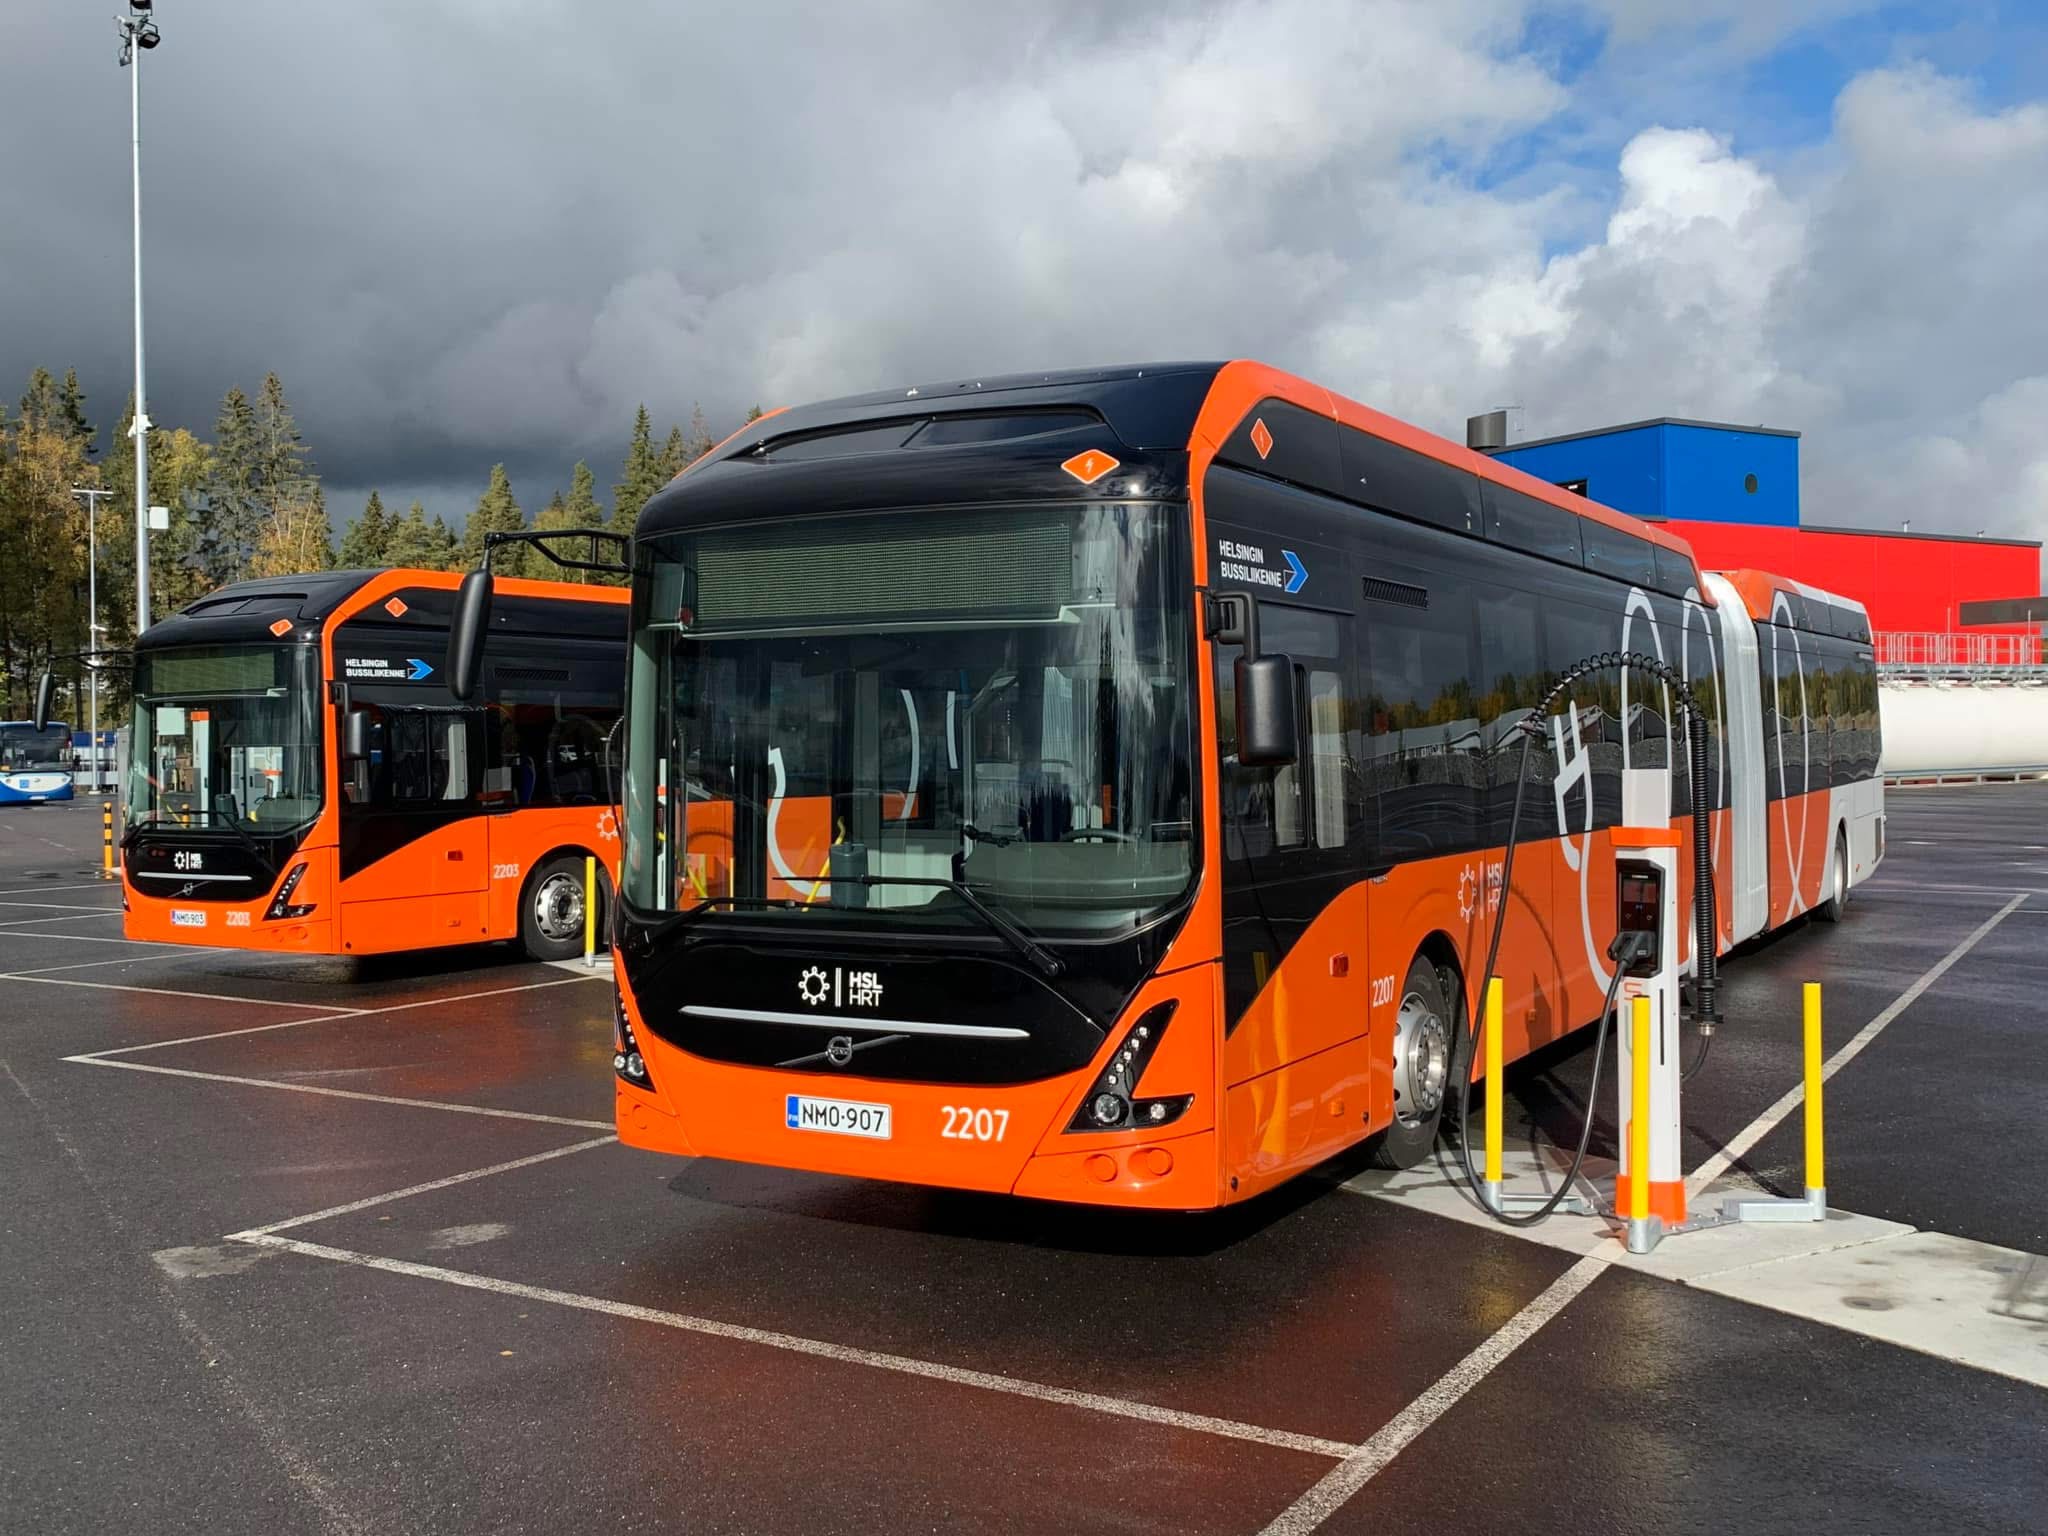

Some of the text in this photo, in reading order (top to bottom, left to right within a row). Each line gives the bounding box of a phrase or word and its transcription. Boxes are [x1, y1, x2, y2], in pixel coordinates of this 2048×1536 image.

[1219, 539, 1264, 564] HELSINGIN
[1221, 561, 1283, 587] BUSSILIIKENNE
[345, 658, 388, 668] HELSINGIN
[346, 668, 406, 678] BUSSILIIKENNE
[493, 863, 519, 879] 2203
[1487, 887, 1502, 912] HR
[849, 971, 883, 990] HSL
[1372, 975, 1395, 1008] 2207
[849, 988, 883, 1007] HRT
[802, 1103, 885, 1133] NMO-907
[940, 1105, 1009, 1142] 2207
